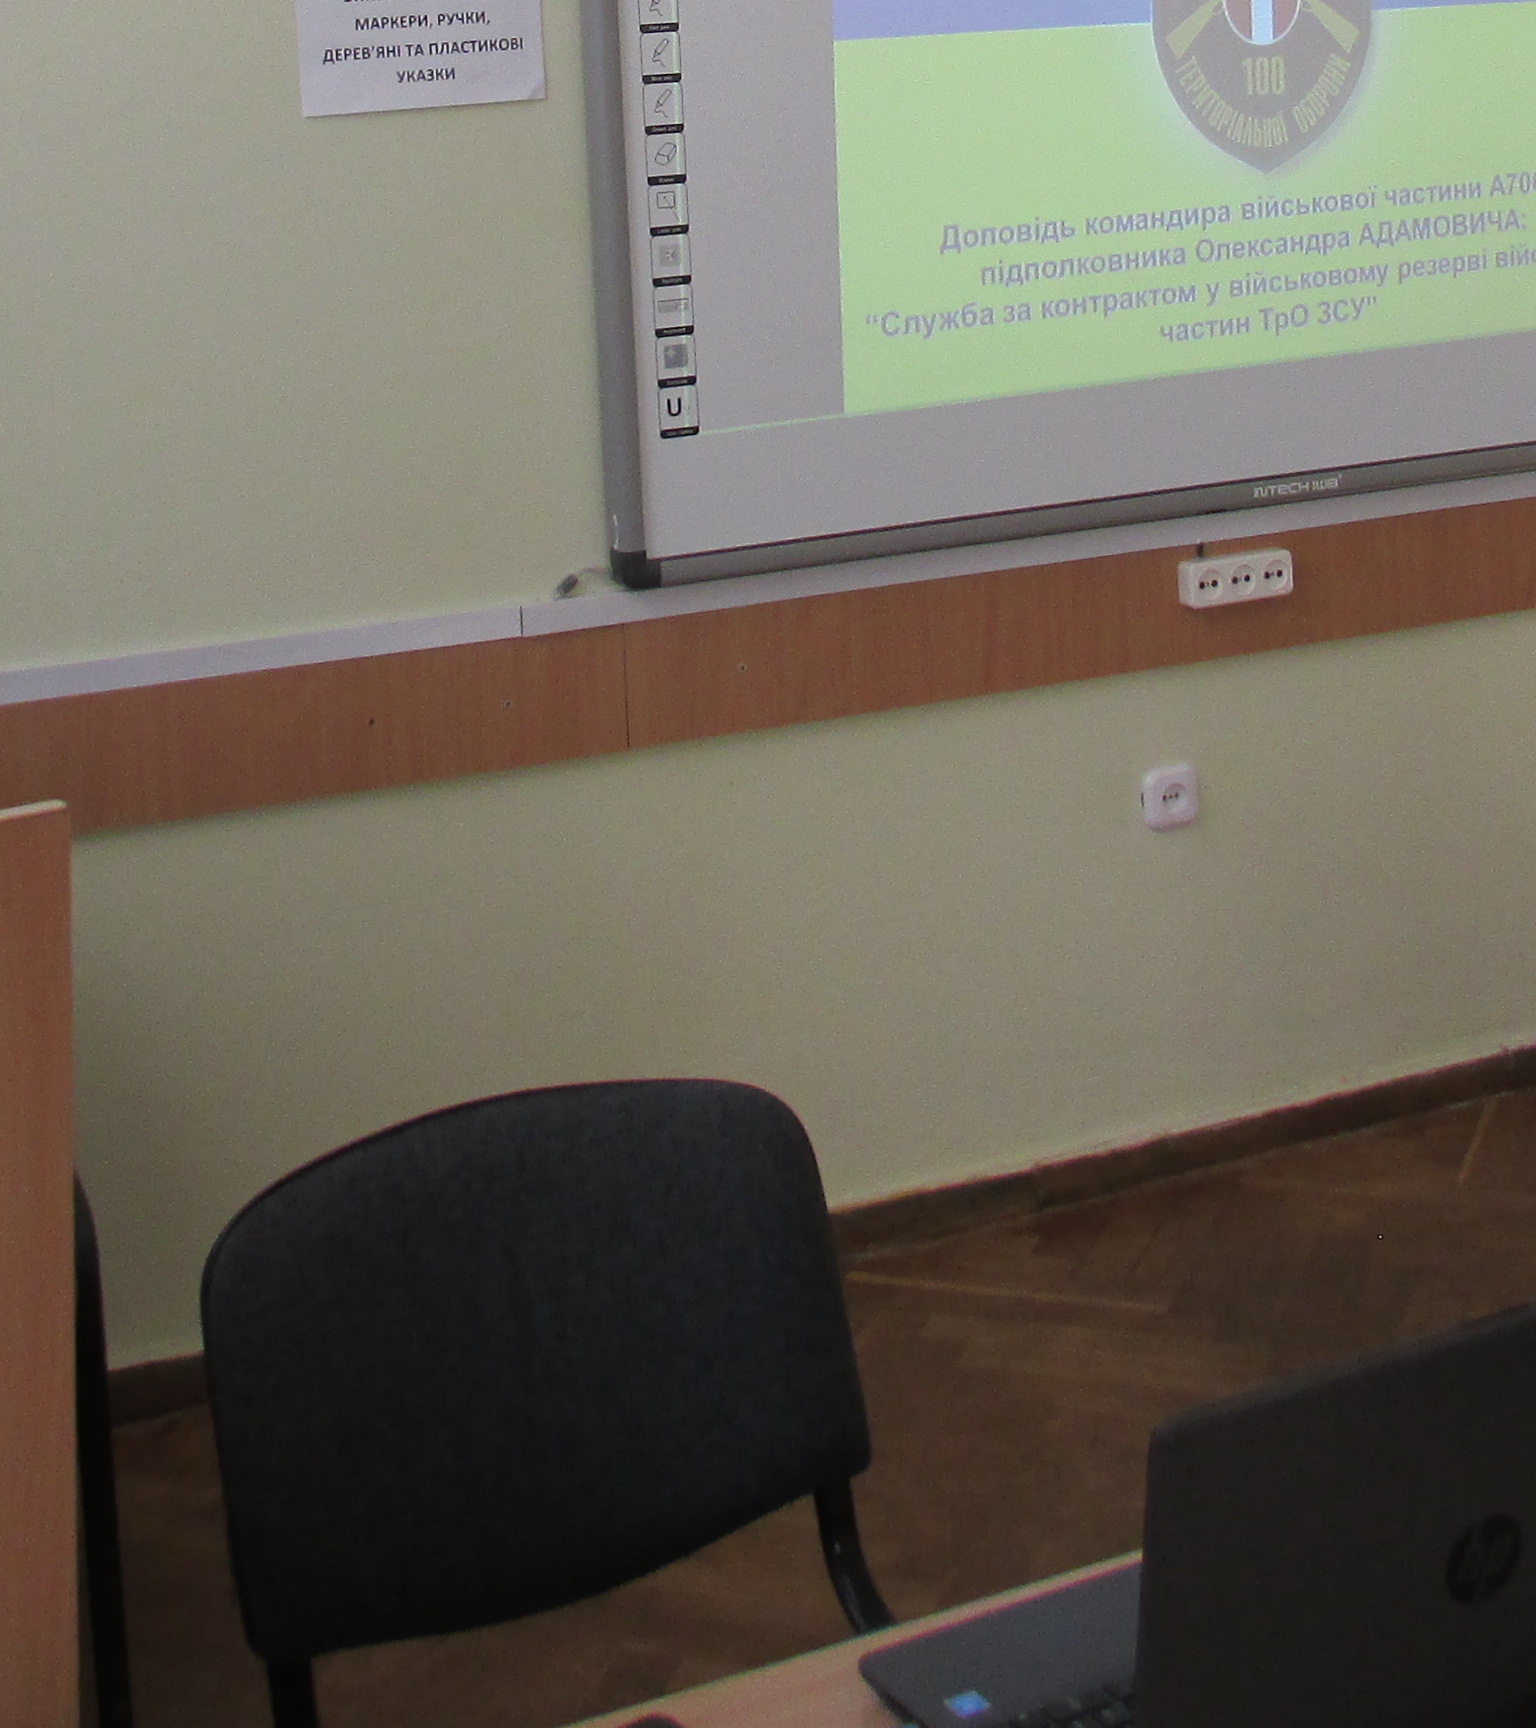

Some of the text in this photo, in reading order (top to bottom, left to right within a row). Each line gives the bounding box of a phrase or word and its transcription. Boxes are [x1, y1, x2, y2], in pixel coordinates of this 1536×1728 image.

[354, 11, 491, 32] МАРКЕРИ, РУЧКИ,
[405, 43, 424, 58] ТА
[428, 37, 524, 57] ПЛАСТИКОВІ
[396, 67, 456, 84] УКАЗКИ
[1242, 57, 1286, 96] 100
[939, 217, 1077, 256] Доповідь
[1084, 204, 1232, 236] командира
[1241, 185, 1378, 221] військової
[1383, 180, 1482, 208] частини
[980, 208, 1528, 288] підполковника Олександра АДАМОВИЧА:
[1002, 301, 1032, 325] за
[1040, 284, 1197, 320] контрактом
[1205, 281, 1220, 307] у
[1229, 261, 1389, 298] військовому
[1396, 247, 1489, 285] резерві
[1159, 313, 1251, 344] частин
[1258, 302, 1310, 336] ТрО
